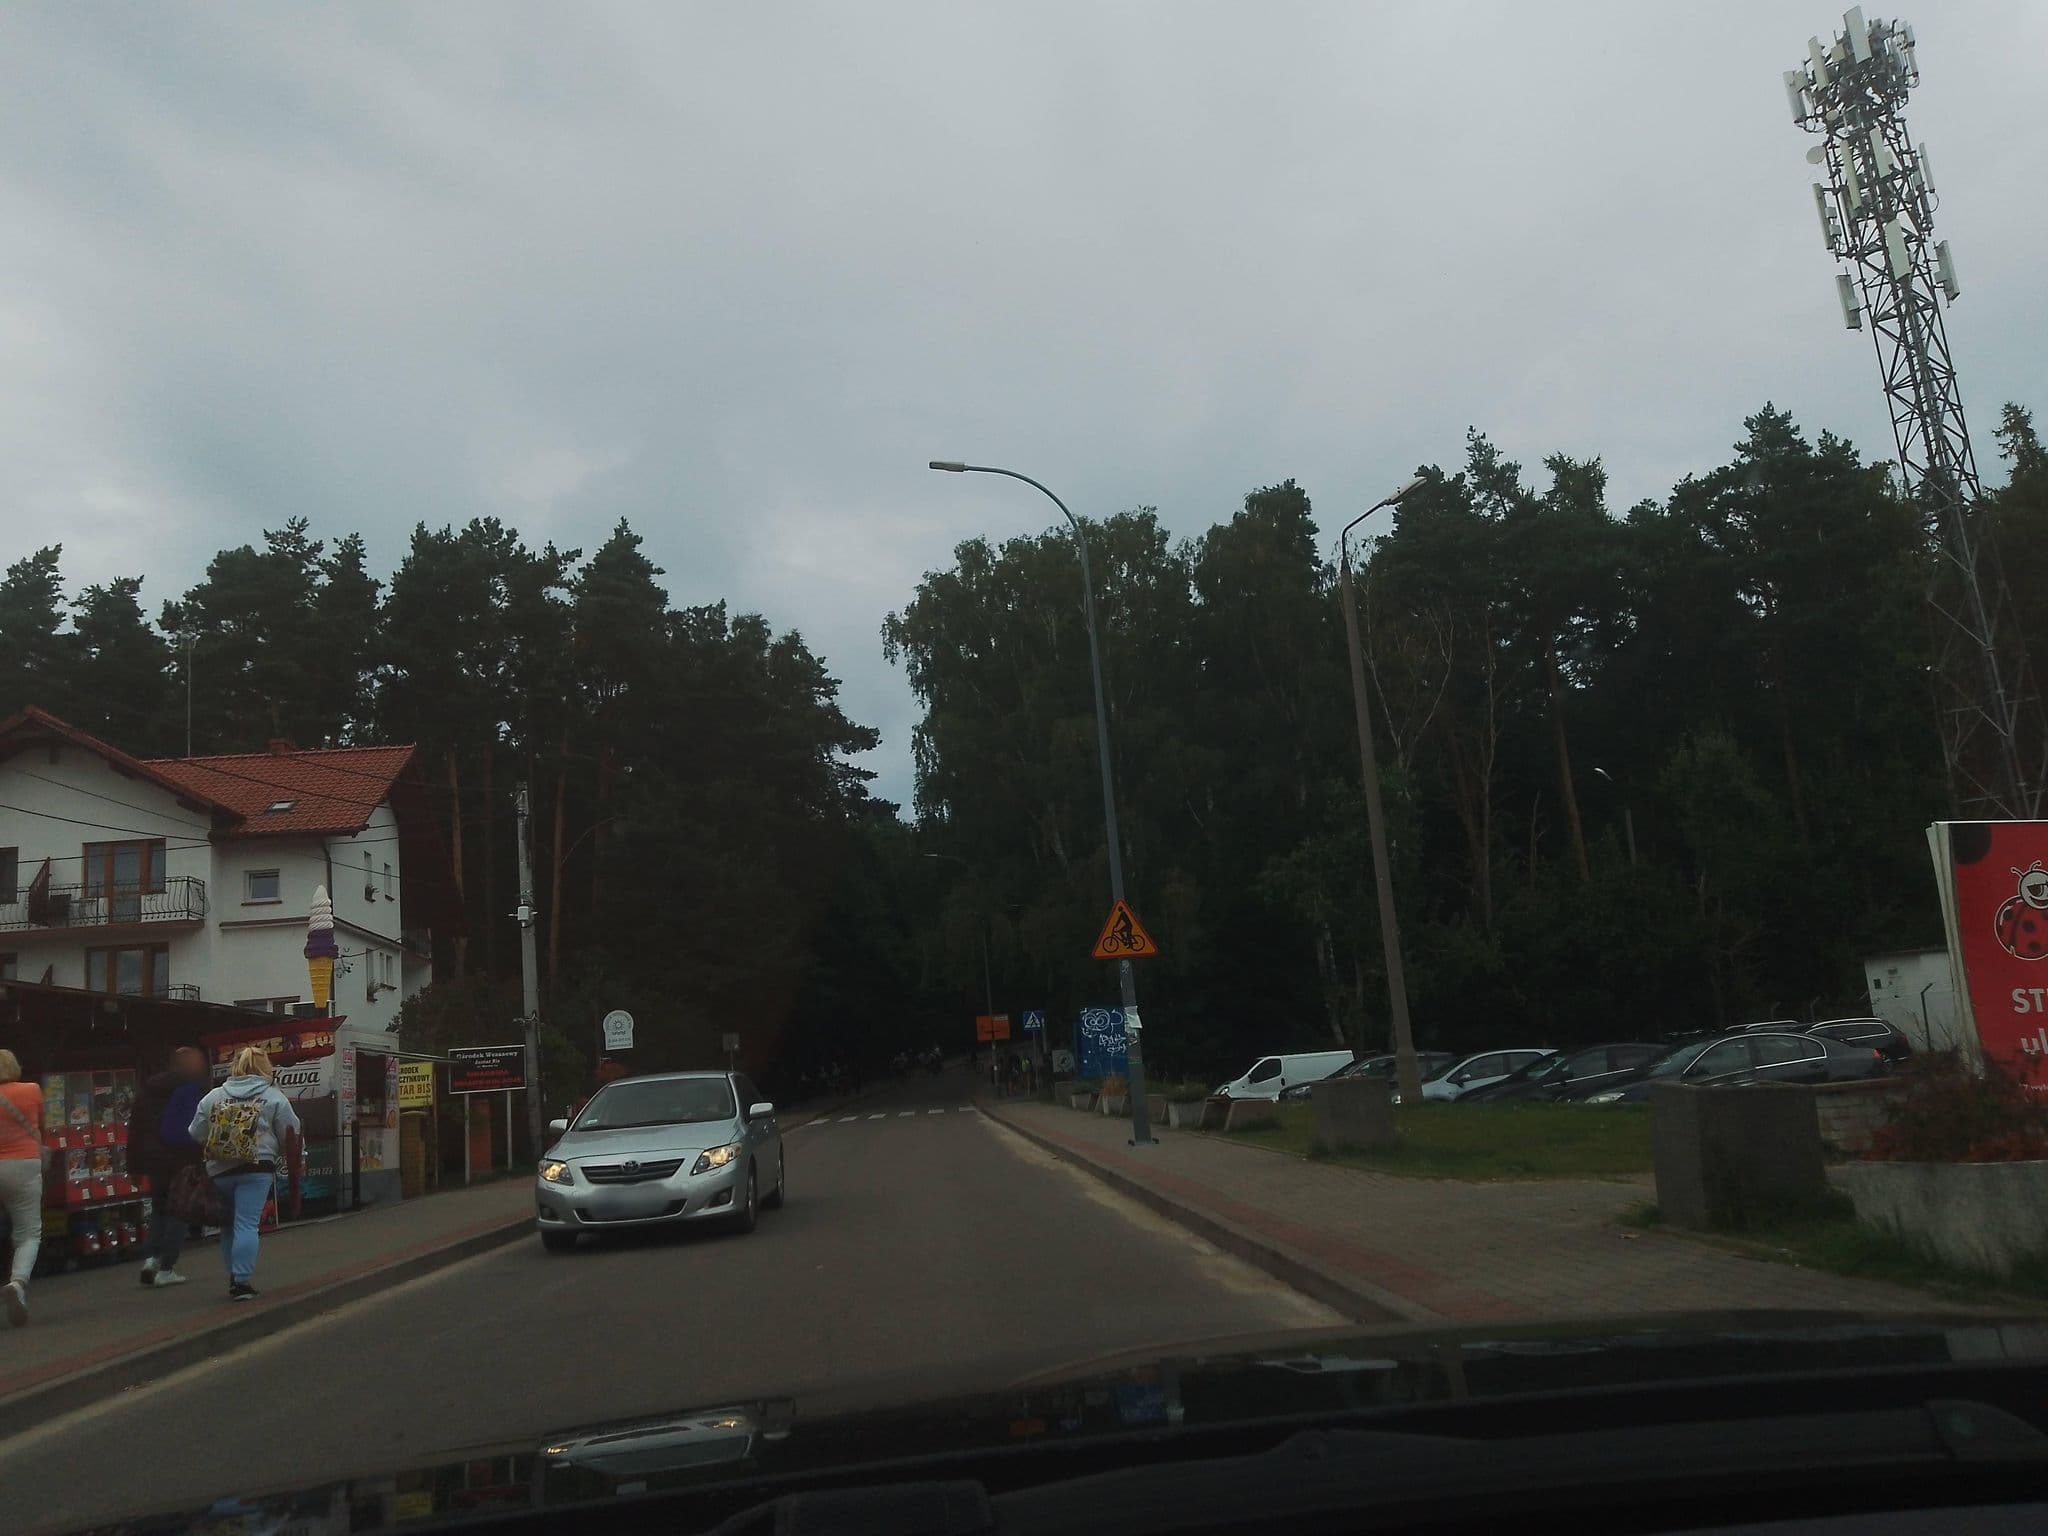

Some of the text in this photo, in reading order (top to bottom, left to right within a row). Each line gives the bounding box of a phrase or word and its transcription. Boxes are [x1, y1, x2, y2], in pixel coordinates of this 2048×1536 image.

[2012, 988, 2048, 1014] ST
[270, 1069, 320, 1086] Kawa
[399, 1066, 419, 1075] RODEK
[400, 1083, 432, 1095] TAR BIS
